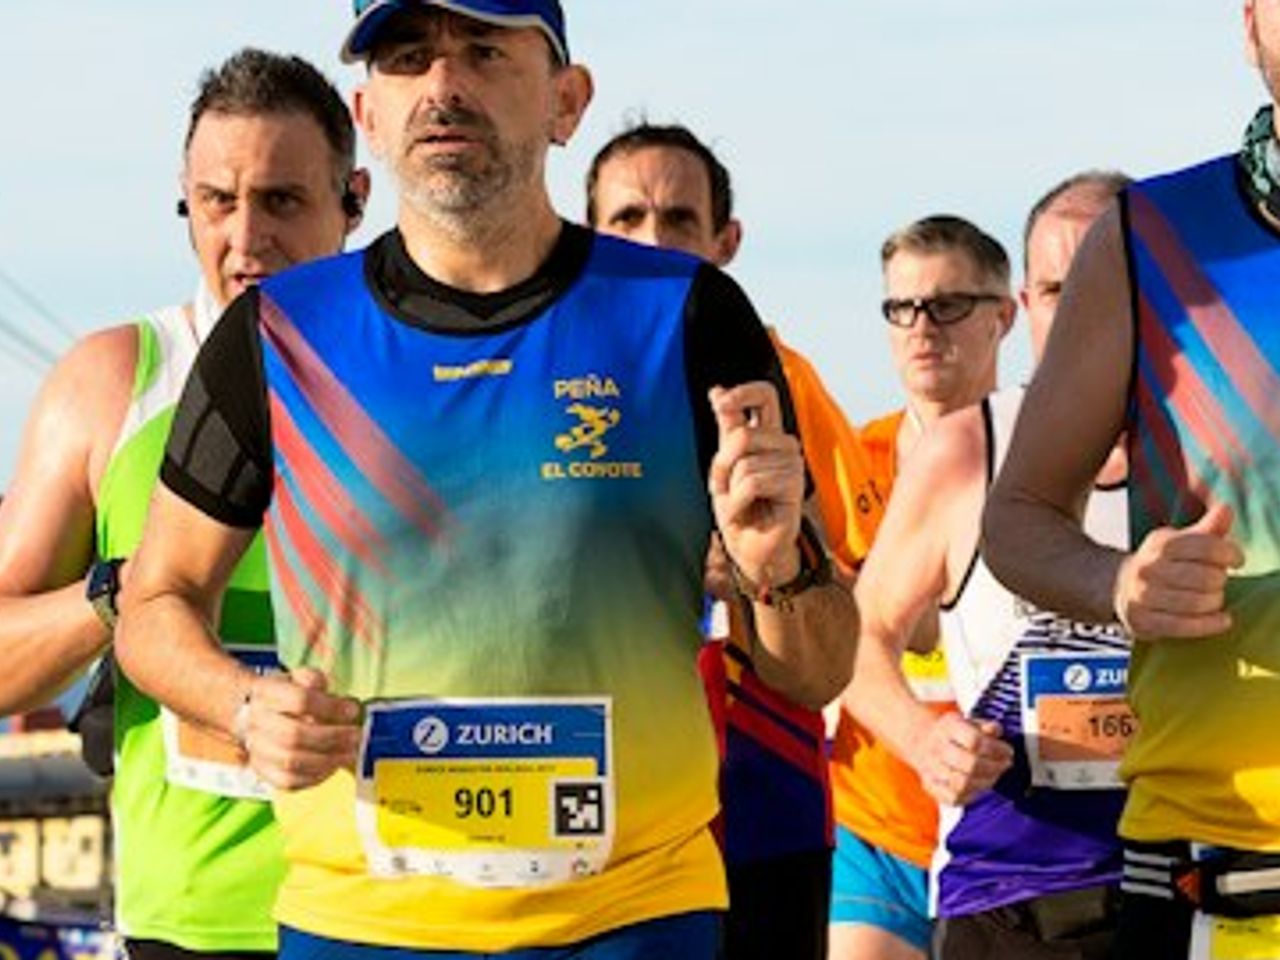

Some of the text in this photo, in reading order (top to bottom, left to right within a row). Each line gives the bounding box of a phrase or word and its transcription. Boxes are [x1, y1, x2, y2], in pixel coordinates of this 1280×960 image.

[554, 374, 619, 400] PEÑA
[540, 461, 643, 479] EL COYOTE
[456, 723, 553, 745] ZURICH
[454, 787, 514, 819] 901
